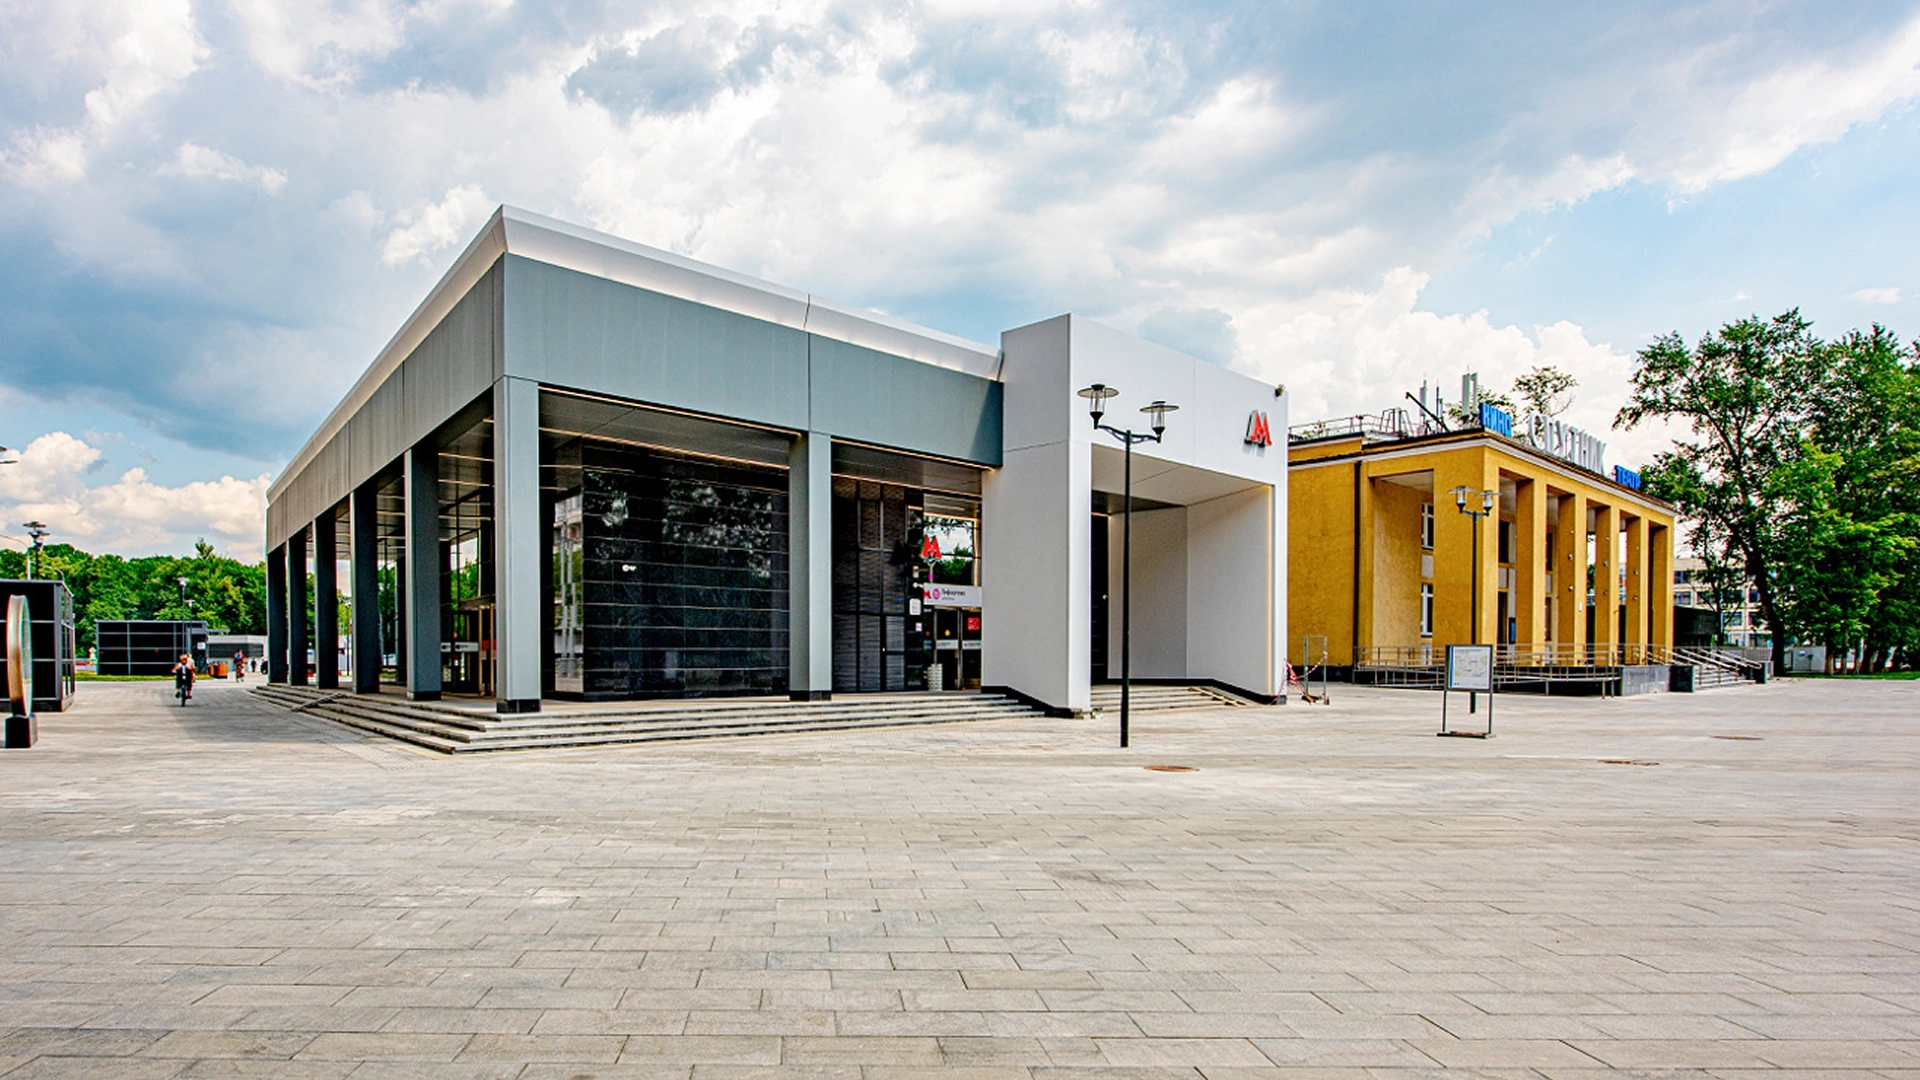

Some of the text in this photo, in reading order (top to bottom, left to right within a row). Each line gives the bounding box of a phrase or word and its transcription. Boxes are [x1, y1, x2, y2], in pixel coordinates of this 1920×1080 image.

[1246, 410, 1273, 447] М
[1480, 400, 1512, 438] КИНО
[1529, 412, 1606, 476] СПУТНИК
[921, 535, 942, 559] М
